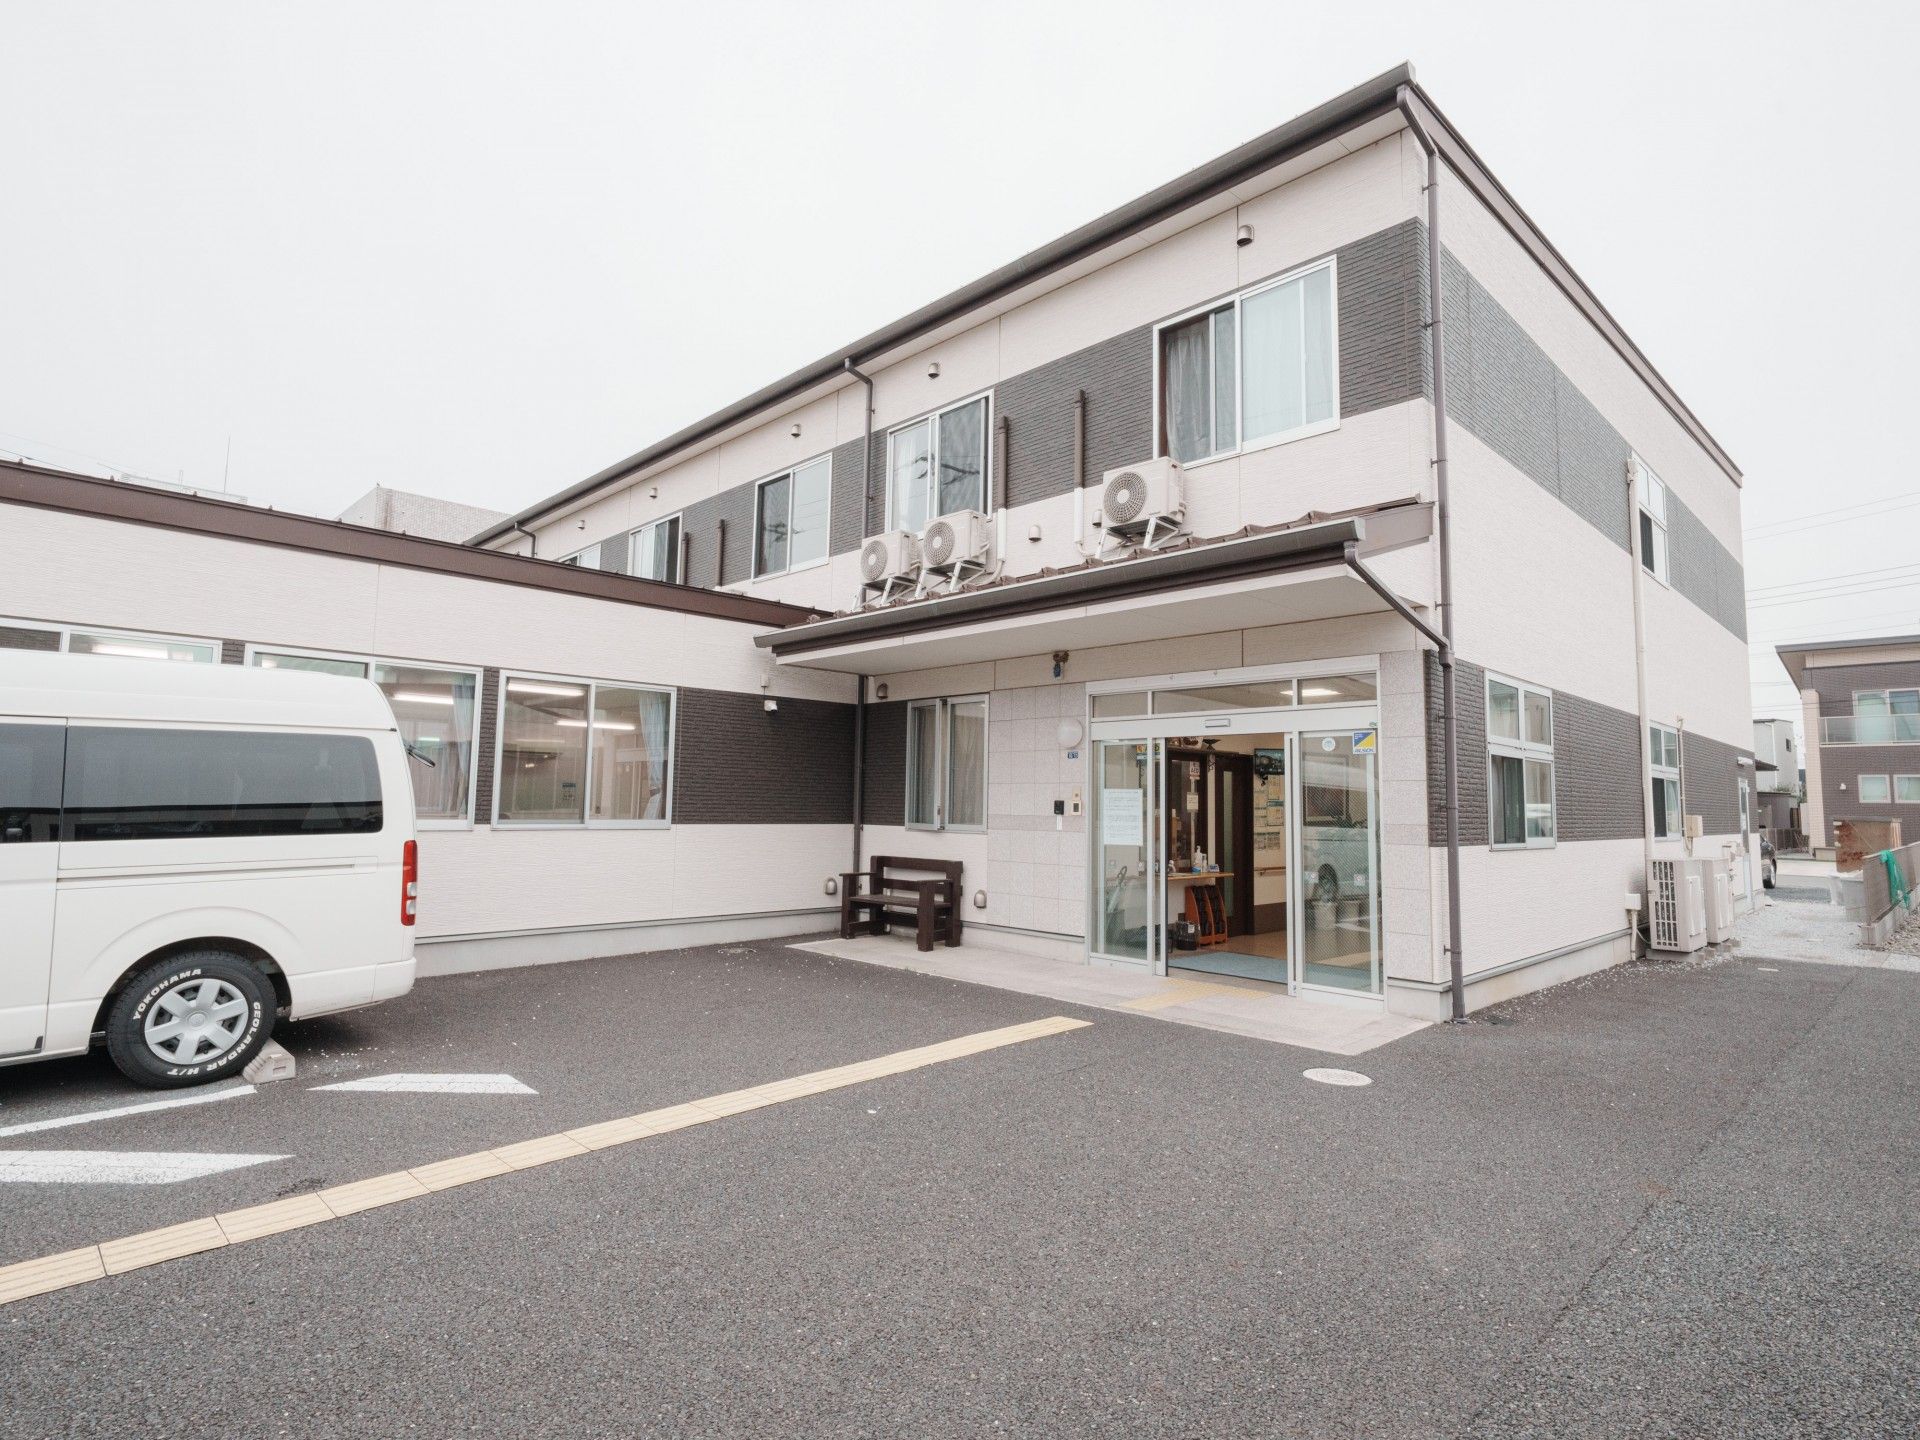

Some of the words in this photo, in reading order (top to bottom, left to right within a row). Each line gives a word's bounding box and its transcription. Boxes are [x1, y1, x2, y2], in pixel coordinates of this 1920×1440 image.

[132, 968, 202, 1020] YOKOHAMA
[206, 1001, 262, 1071] GEOLANDAR
[167, 1067, 200, 1076] H/T
